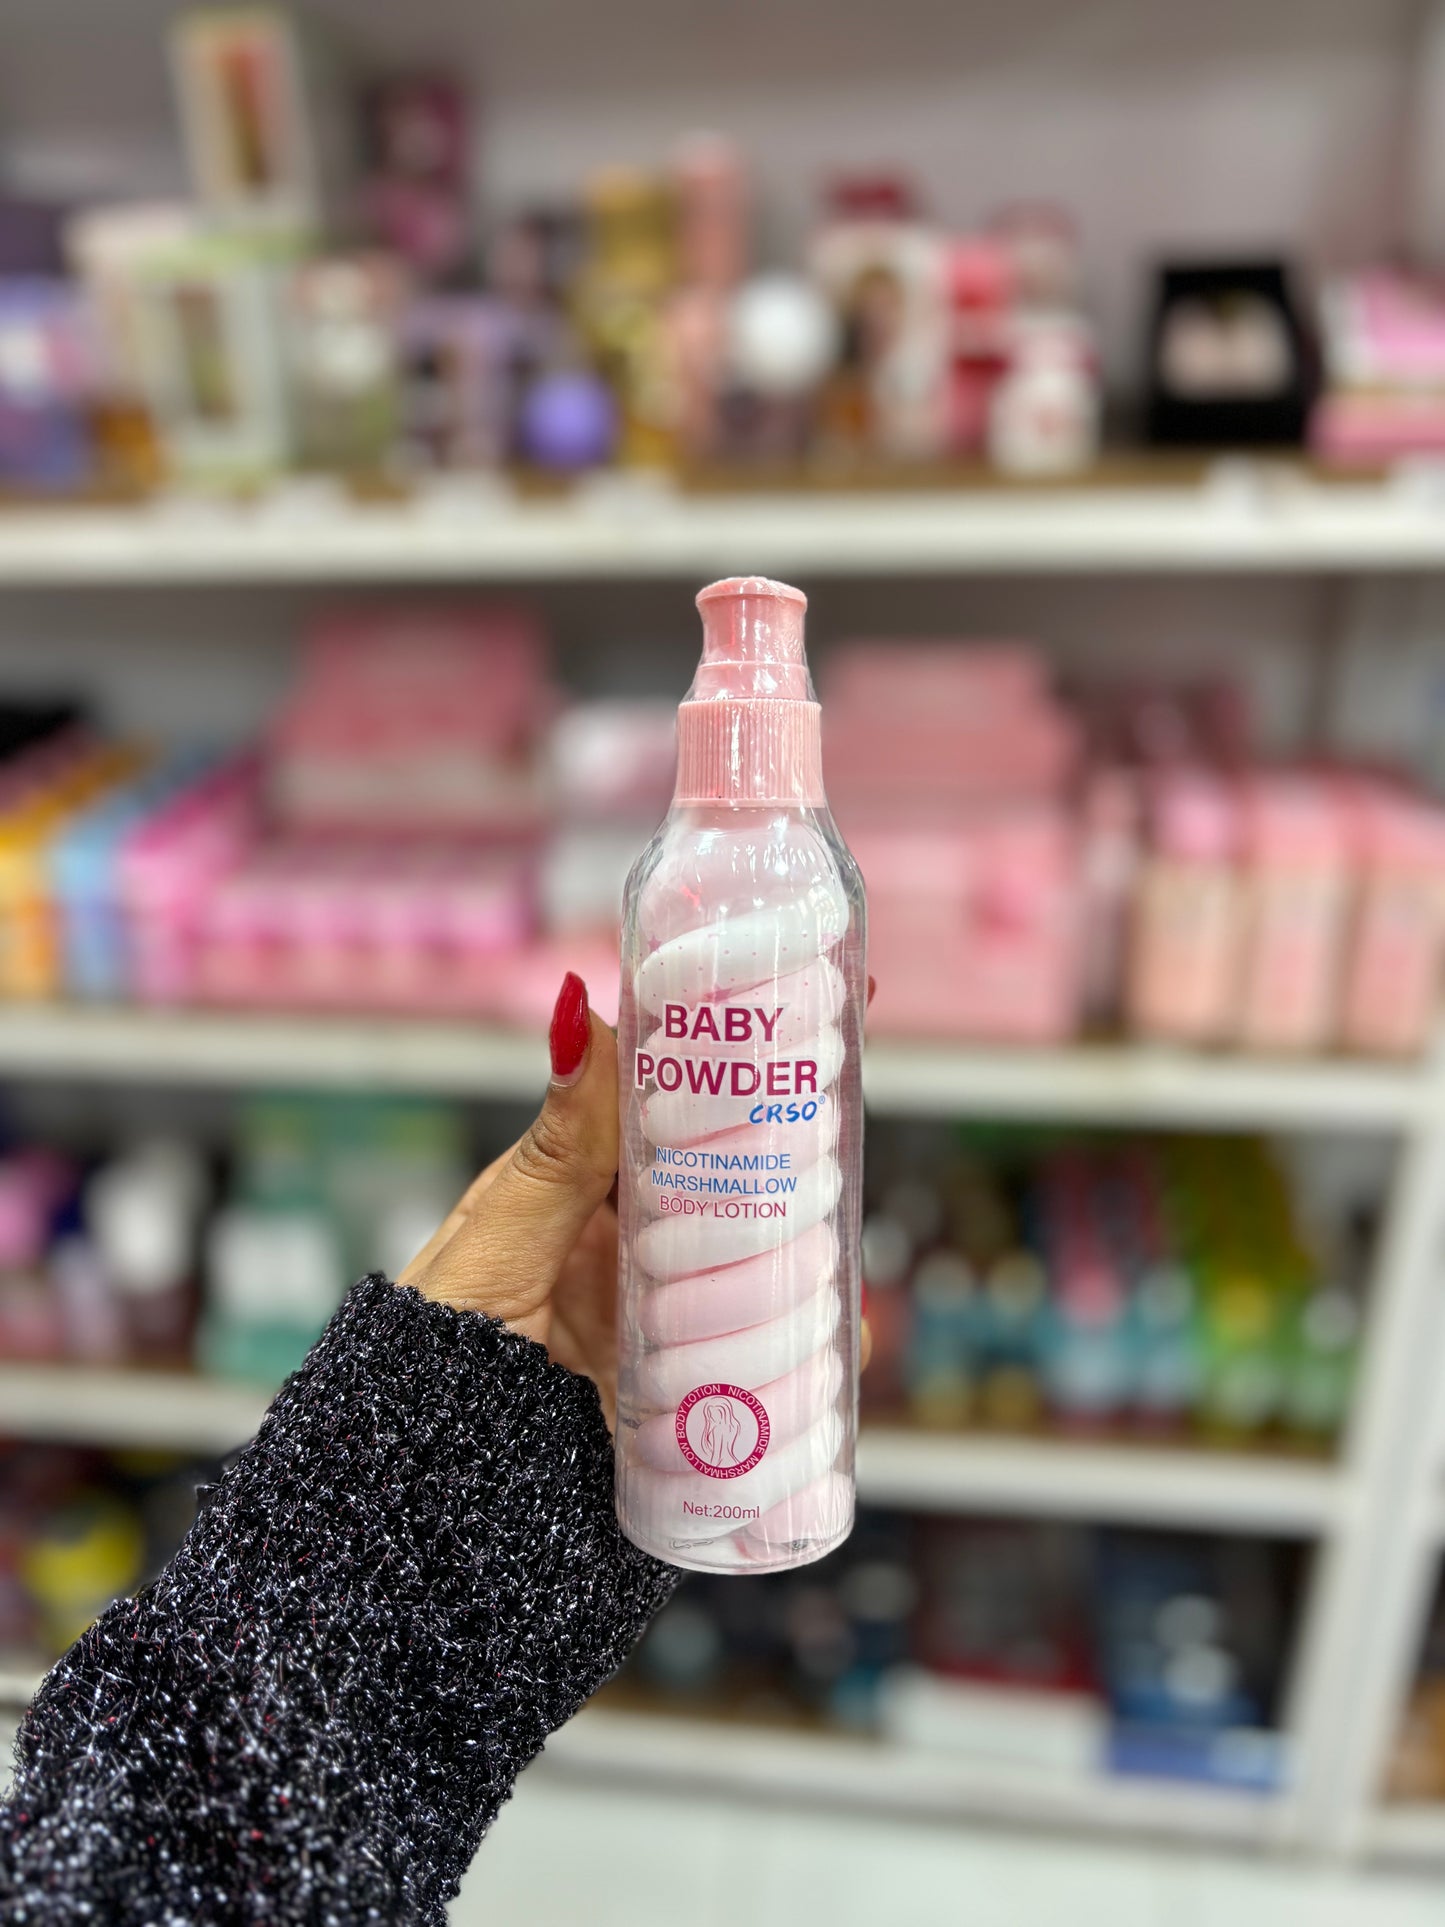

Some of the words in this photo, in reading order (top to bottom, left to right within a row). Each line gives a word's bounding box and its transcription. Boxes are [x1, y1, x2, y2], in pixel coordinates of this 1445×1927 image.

[665, 1004, 784, 1042] BABY
[637, 1053, 818, 1096] POWDER
[656, 1147, 791, 1170] NICOTINAMIDE
[652, 1170, 797, 1194] MARSHMALLOW
[660, 1195, 708, 1216] BODY
[714, 1201, 787, 1218] LOTION
[682, 1384, 721, 1408] LOTION
[676, 1407, 687, 1439] BODY
[728, 1386, 769, 1455] NICOTINAMIDE
[680, 1441, 759, 1479] MARSHMALLOW
[683, 1501, 760, 1518] Net:200ml
